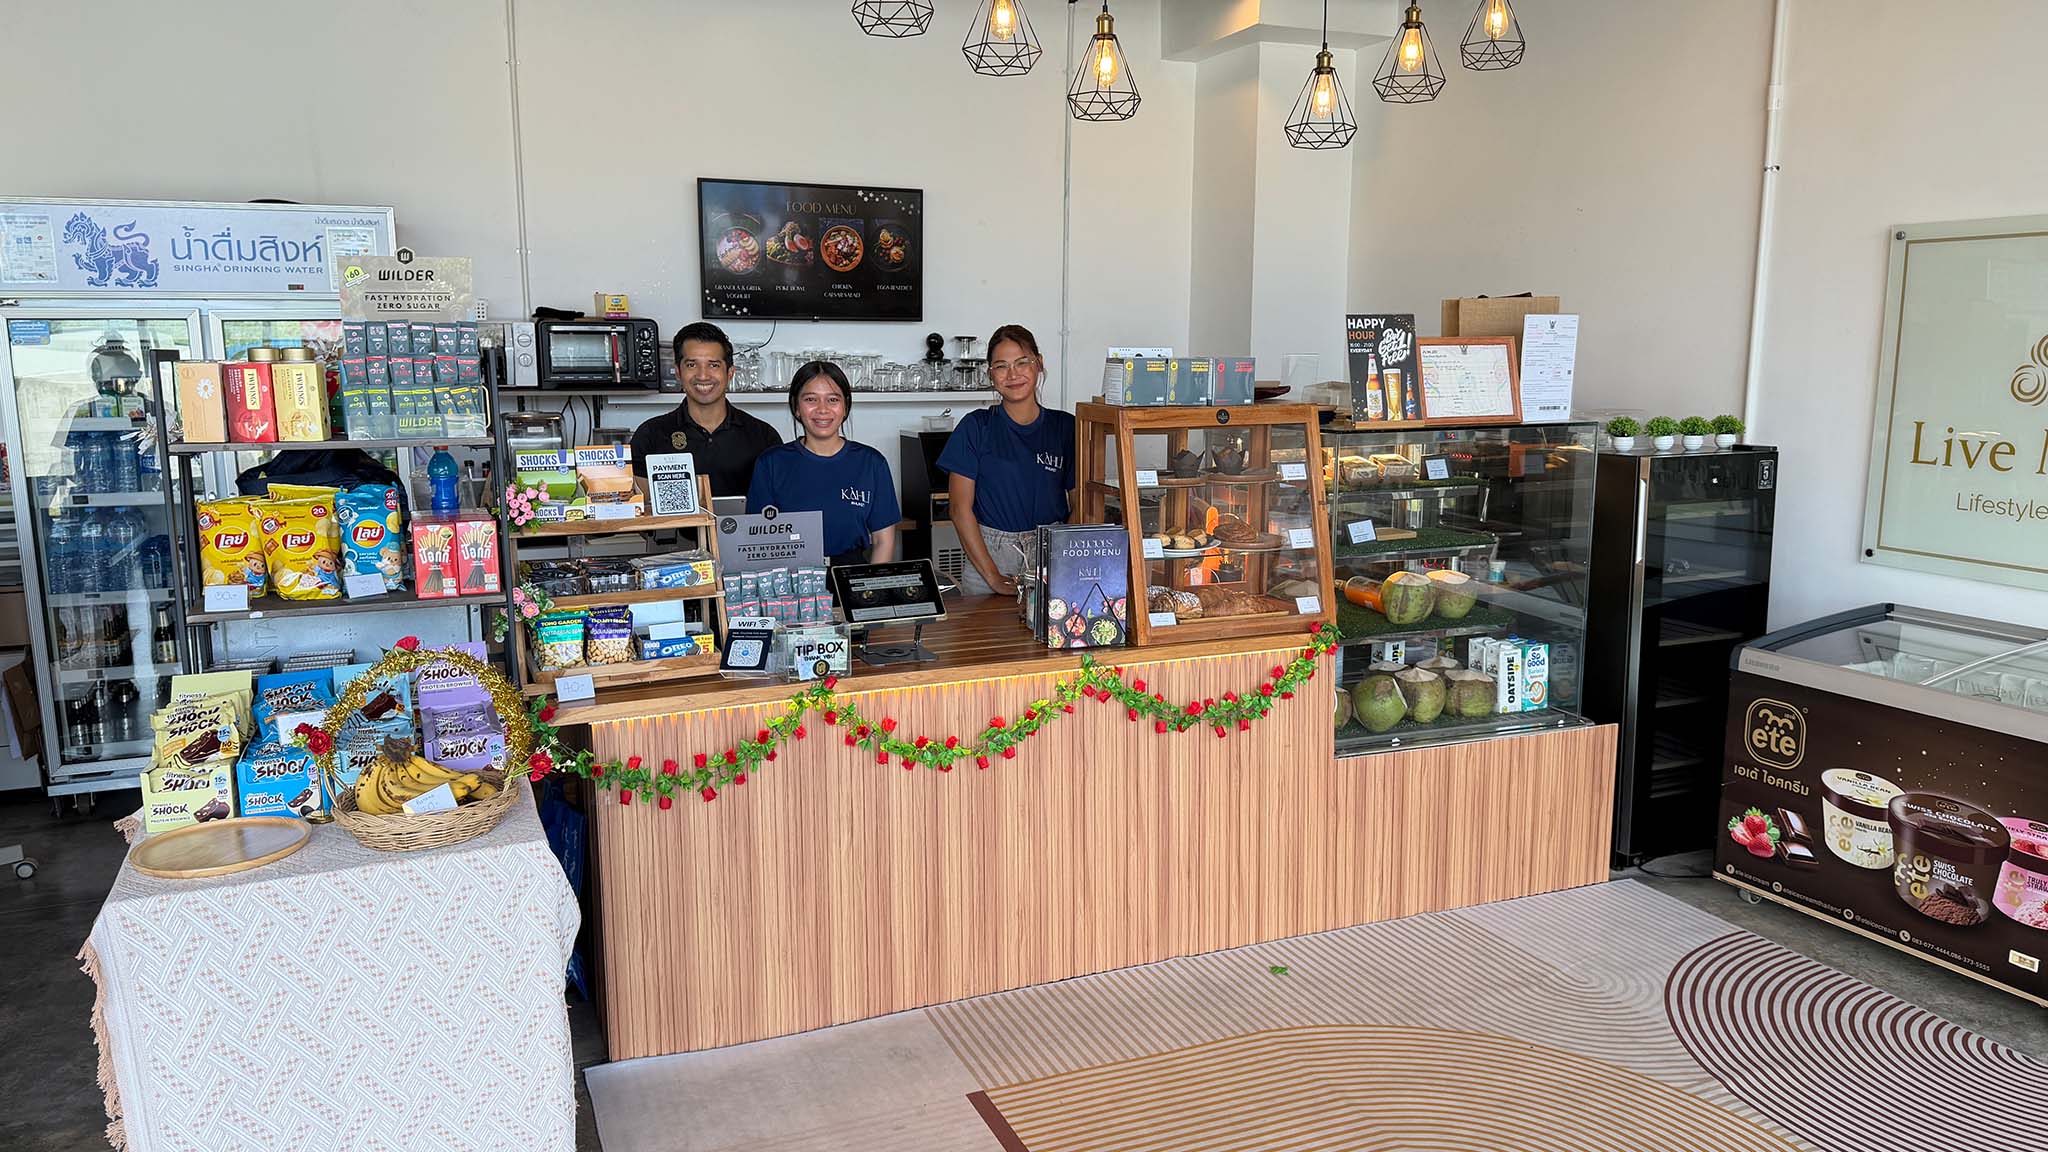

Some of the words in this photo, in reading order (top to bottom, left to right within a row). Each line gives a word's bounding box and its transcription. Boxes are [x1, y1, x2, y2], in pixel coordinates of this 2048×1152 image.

[786, 201, 822, 213] FOOD
[825, 203, 857, 215] MENU
[171, 226, 323, 263] น้ำดื่มสิงห์
[174, 264, 219, 272] SINGHA
[224, 265, 281, 273] DRINKING
[285, 266, 323, 274] WATER
[378, 270, 434, 282] WILDER
[364, 294, 388, 302] FAST
[393, 294, 451, 302] HYDRATION
[1347, 318, 1386, 329] HAPPY
[1348, 330, 1375, 340] HOUR
[247, 372, 257, 406] TWININGS
[295, 372, 305, 406] TWININGS
[400, 416, 442, 428] WILDER
[1909, 420, 2016, 472] Live
[520, 454, 557, 466] SHOCKS
[579, 449, 615, 461] SHOCKS
[652, 463, 688, 472] PAYMENT
[1763, 465, 1769, 480] 5
[1956, 492, 2048, 522] Lifestyle
[355, 525, 382, 541] เลย์
[749, 523, 793, 536] WILDER
[218, 531, 247, 550] เลย์
[285, 531, 314, 550] เลย์
[760, 543, 805, 551] HYDRATION
[770, 550, 797, 558] SUGAR
[1062, 549, 1090, 557] FOOD
[1094, 548, 1121, 556] MENU
[663, 569, 692, 584] OREO
[701, 570, 709, 580] 5
[661, 642, 693, 655] OREO
[702, 644, 710, 653] 5
[795, 644, 815, 657] TIP
[817, 641, 844, 655] BOX
[1527, 658, 1545, 668] Good
[1531, 652, 1541, 661] So
[423, 667, 470, 680] SHOCK
[1506, 656, 1516, 704] OATSIDE
[167, 713, 222, 740] SHOCK
[1751, 727, 1796, 757] ete
[1836, 775, 1869, 788] VANILLA
[1869, 784, 1892, 794] BEAN
[247, 794, 283, 806] SHOCK
[151, 804, 188, 816] SHOCK
[1855, 820, 1878, 832] VANILLA
[1935, 810, 1999, 833] CHOCOLATE
[1933, 859, 1956, 873] SWISS
[1932, 867, 1974, 887] CHOCOLATE
